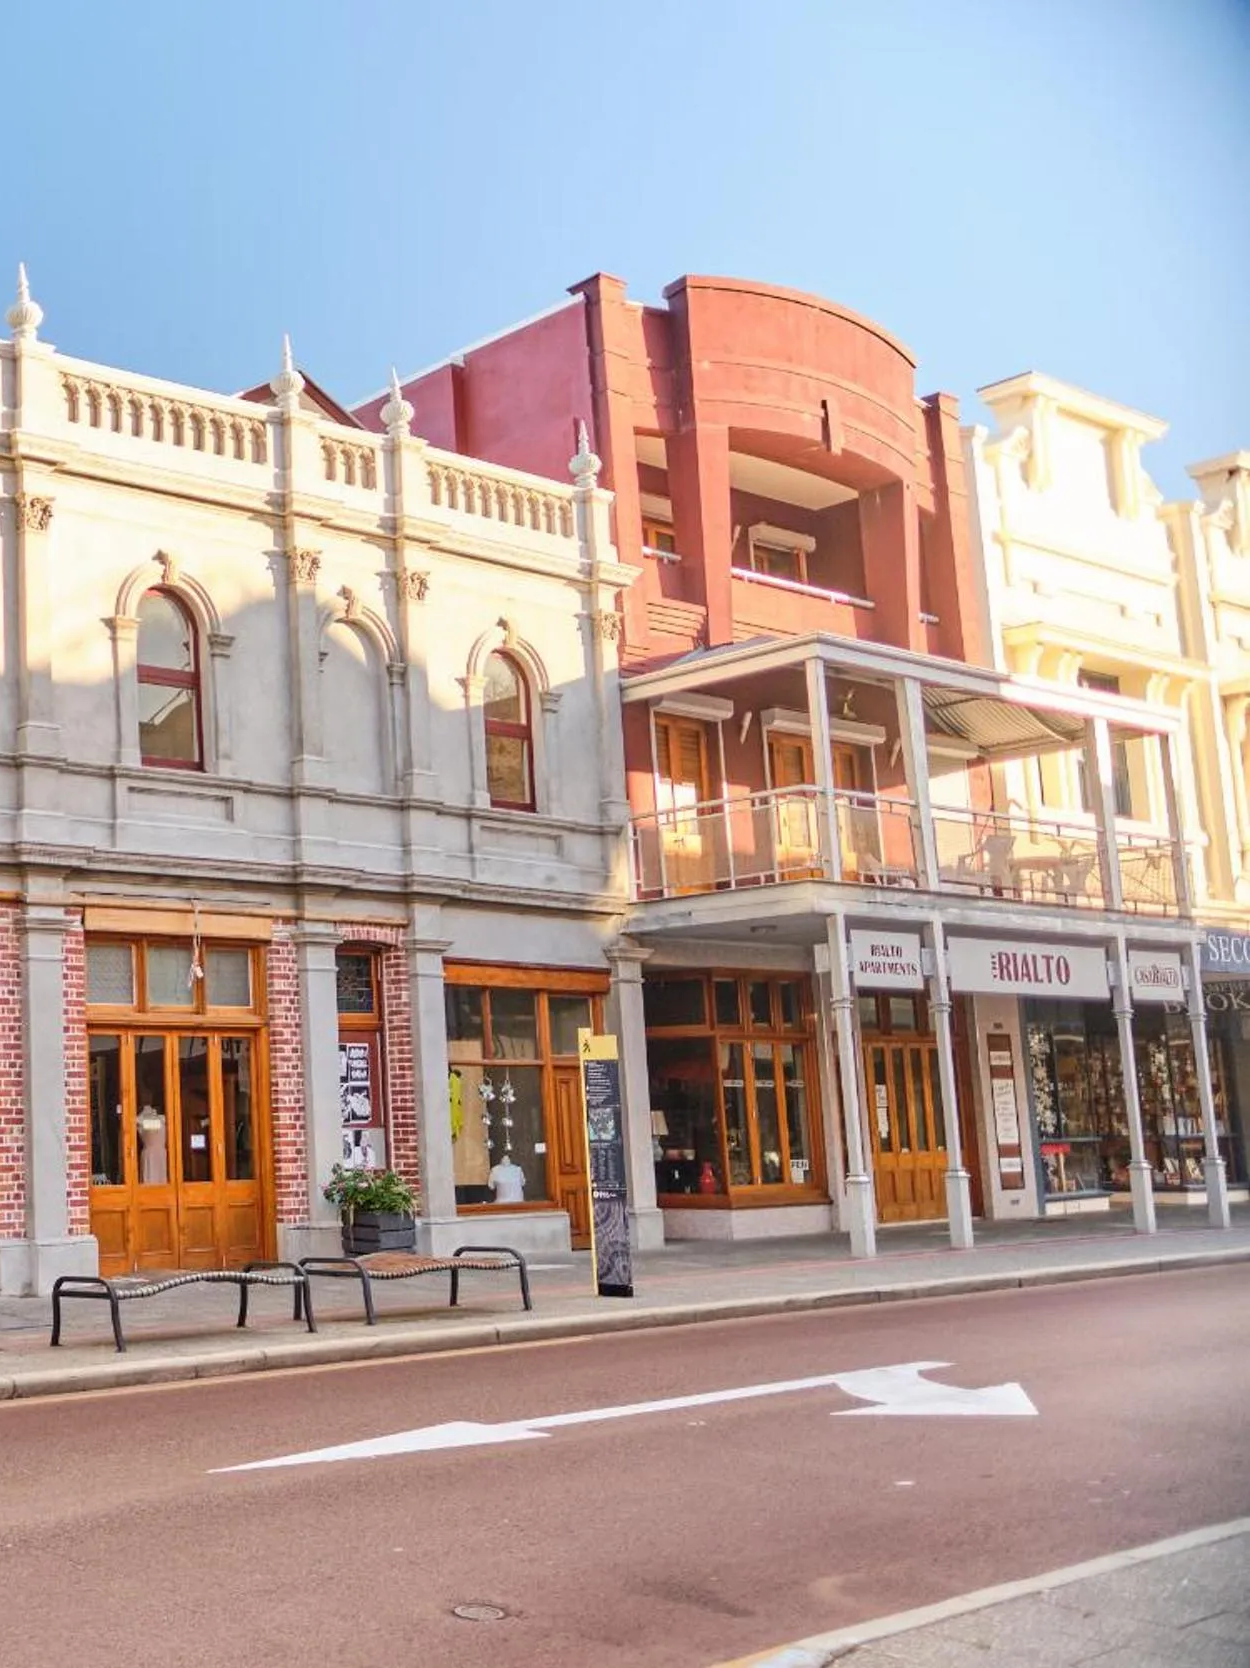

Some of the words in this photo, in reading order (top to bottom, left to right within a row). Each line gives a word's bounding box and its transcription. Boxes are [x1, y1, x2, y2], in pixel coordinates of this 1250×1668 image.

[870, 944, 903, 958] RIALTO
[859, 960, 918, 976] APARTMENTS
[998, 951, 1071, 985] RIALTO
